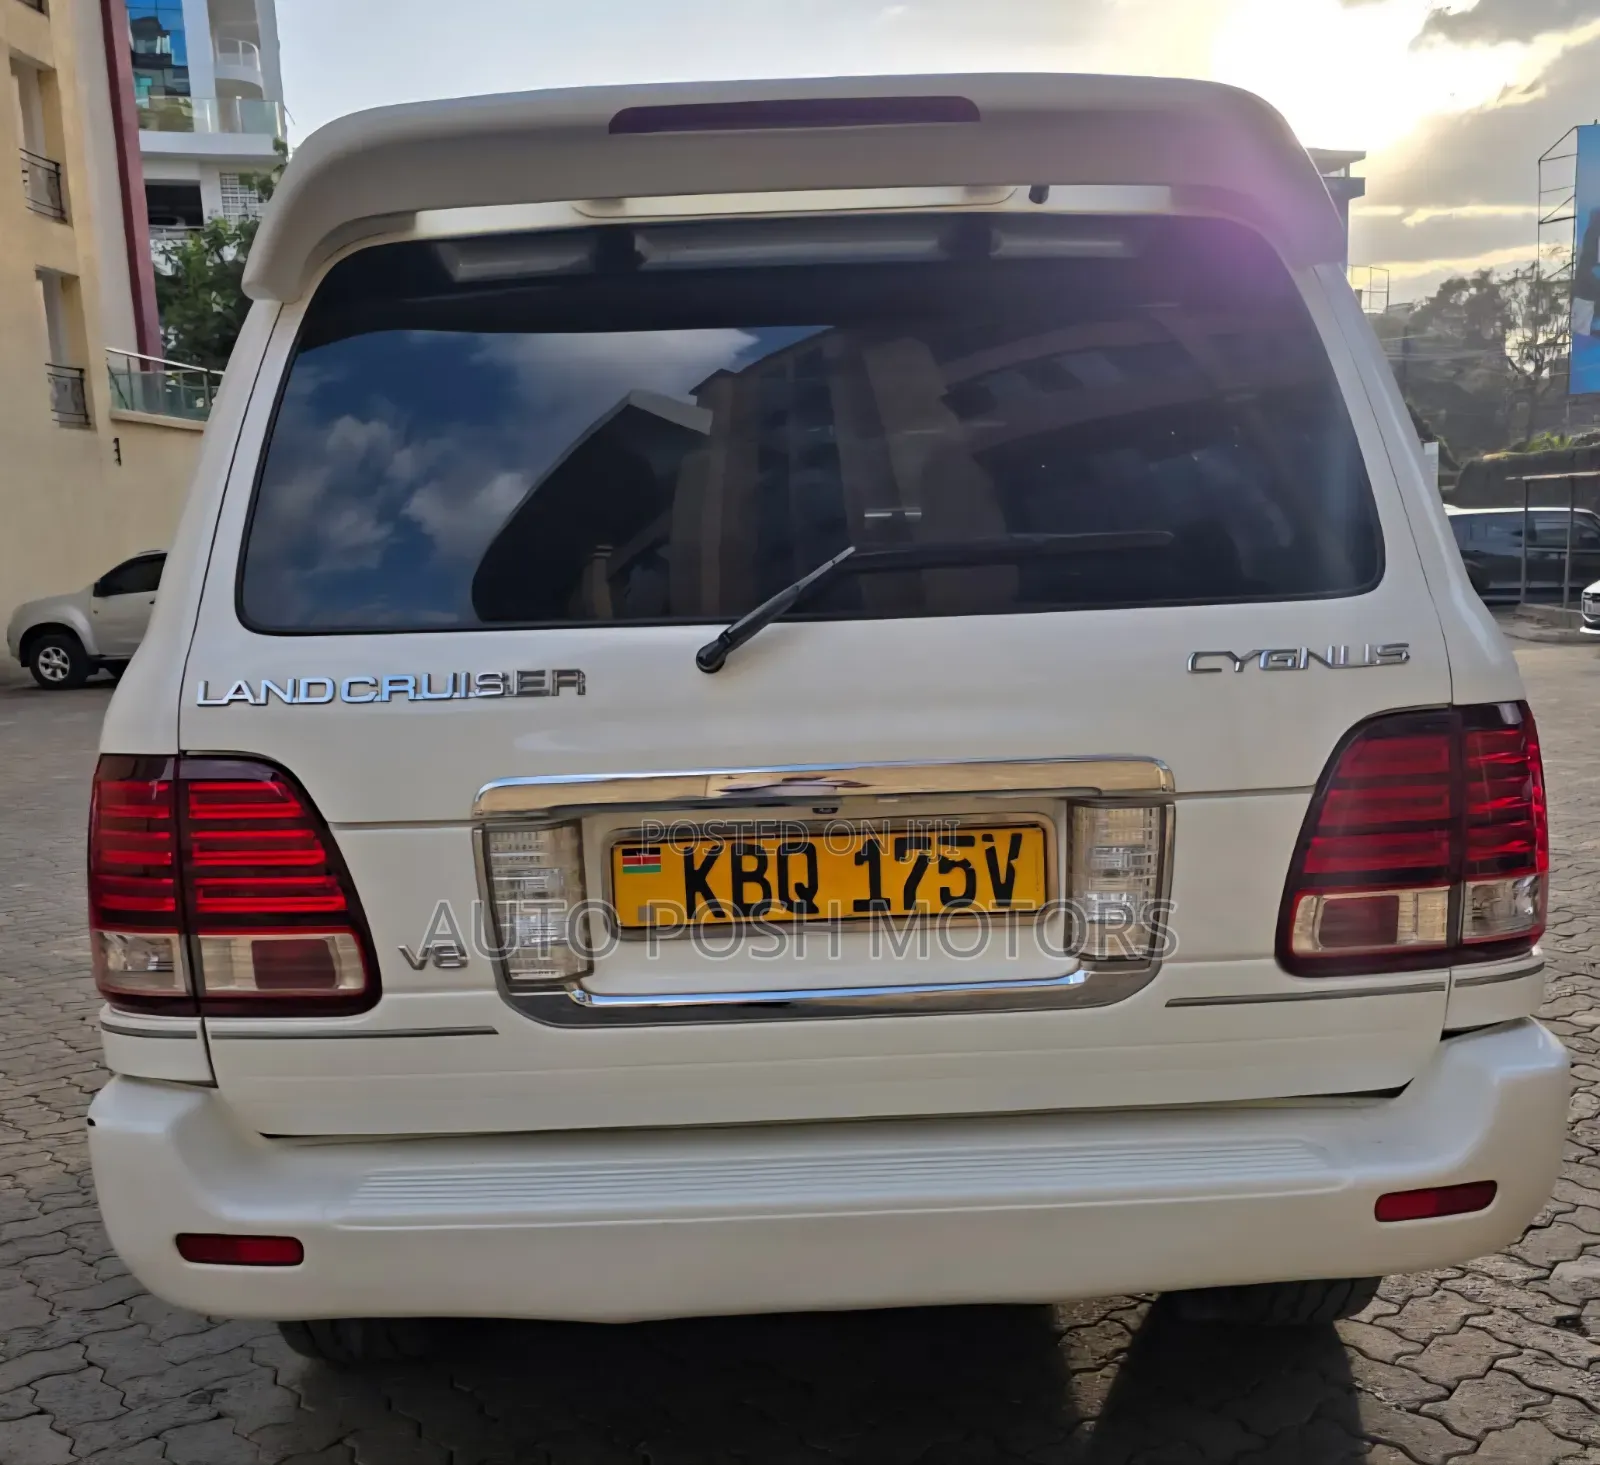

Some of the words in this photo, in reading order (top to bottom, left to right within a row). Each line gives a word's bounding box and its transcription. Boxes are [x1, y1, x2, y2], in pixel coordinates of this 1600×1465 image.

[1187, 643, 1411, 673] CYGNUS
[683, 841, 820, 920] KBQ
[853, 833, 1023, 911] 175V
[397, 944, 469, 970] V8
